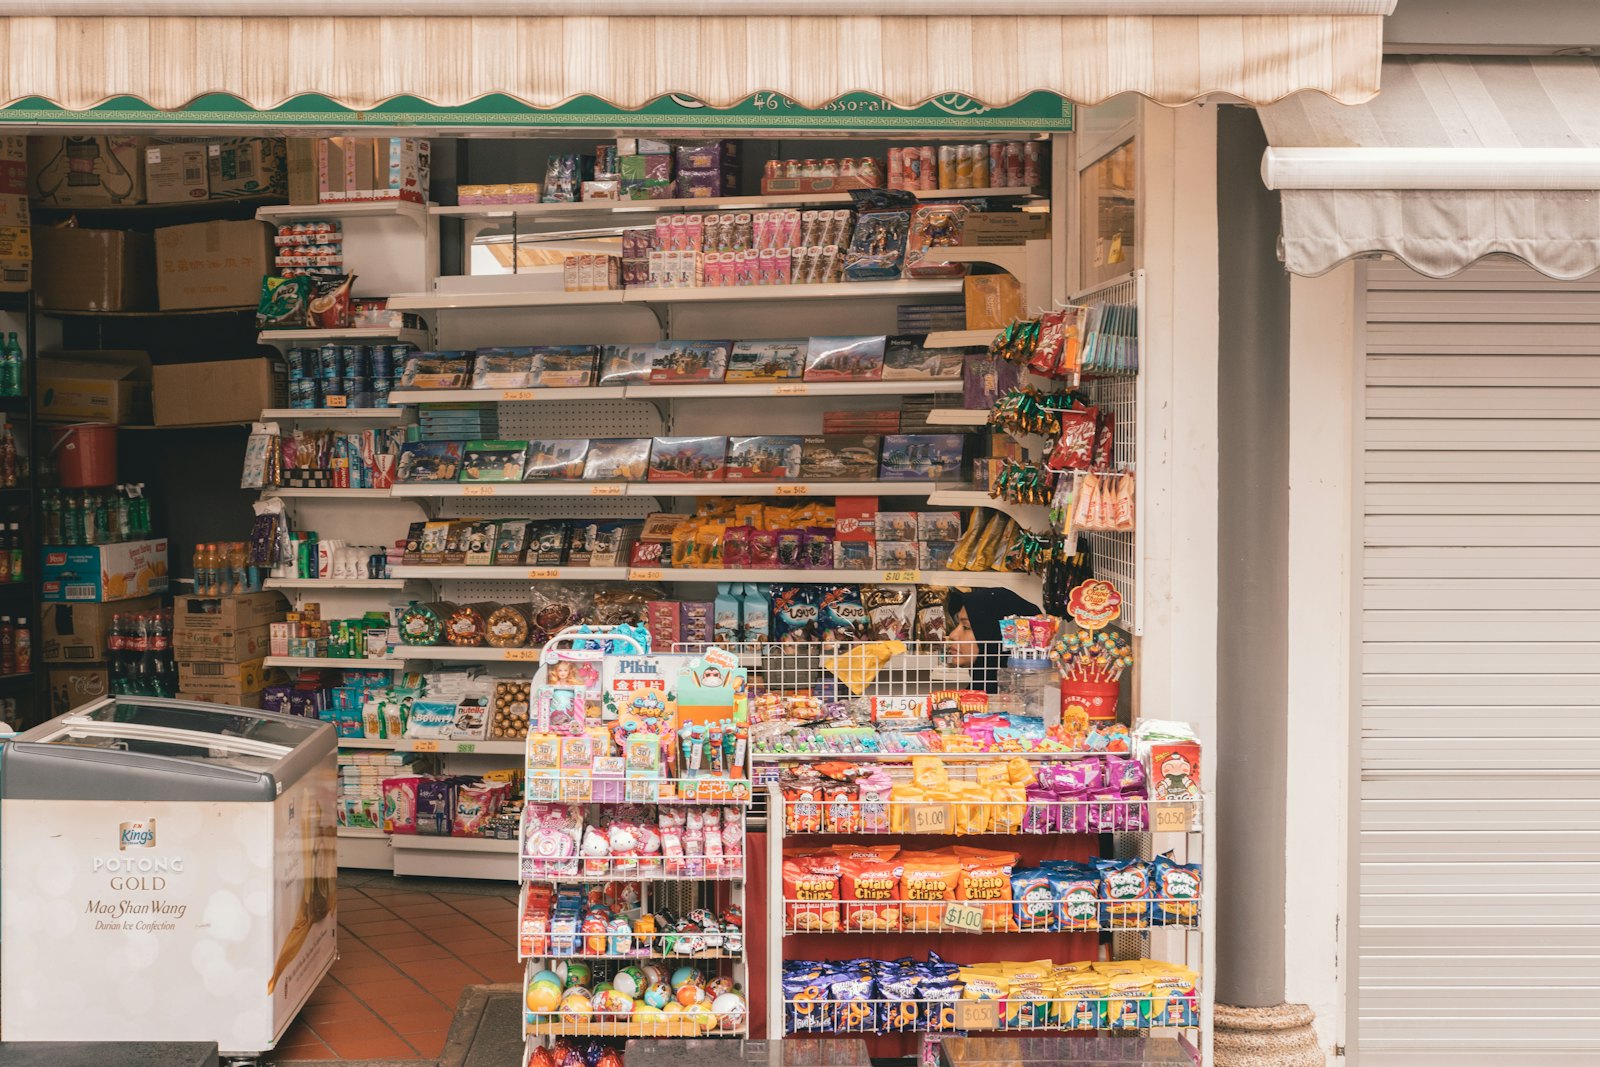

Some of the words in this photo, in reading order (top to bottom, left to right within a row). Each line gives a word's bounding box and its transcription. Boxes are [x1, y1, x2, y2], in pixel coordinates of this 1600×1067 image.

[753, 93, 778, 110] 46
[885, 573, 901, 581] $10
[458, 706, 485, 715] nutella
[916, 810, 944, 826] $1.00
[1156, 811, 1185, 825] $0.50
[121, 829, 154, 846] King's
[92, 856, 185, 873] POTONG
[110, 876, 166, 891] GOLD
[795, 880, 835, 892] Potato
[854, 879, 894, 890] Potato
[907, 880, 947, 891] Potato
[964, 877, 1004, 889] Potato
[796, 889, 833, 901] Chips
[855, 888, 891, 900] Chips
[908, 889, 944, 901] Chips
[965, 887, 1001, 900] Chips
[84, 900, 116, 914] Mao
[111, 899, 149, 919] Shan
[151, 900, 188, 920] Wang
[946, 906, 983, 928] $1.00
[95, 920, 121, 931] Durian
[122, 920, 134, 931] Ice
[135, 920, 176, 934] Confection
